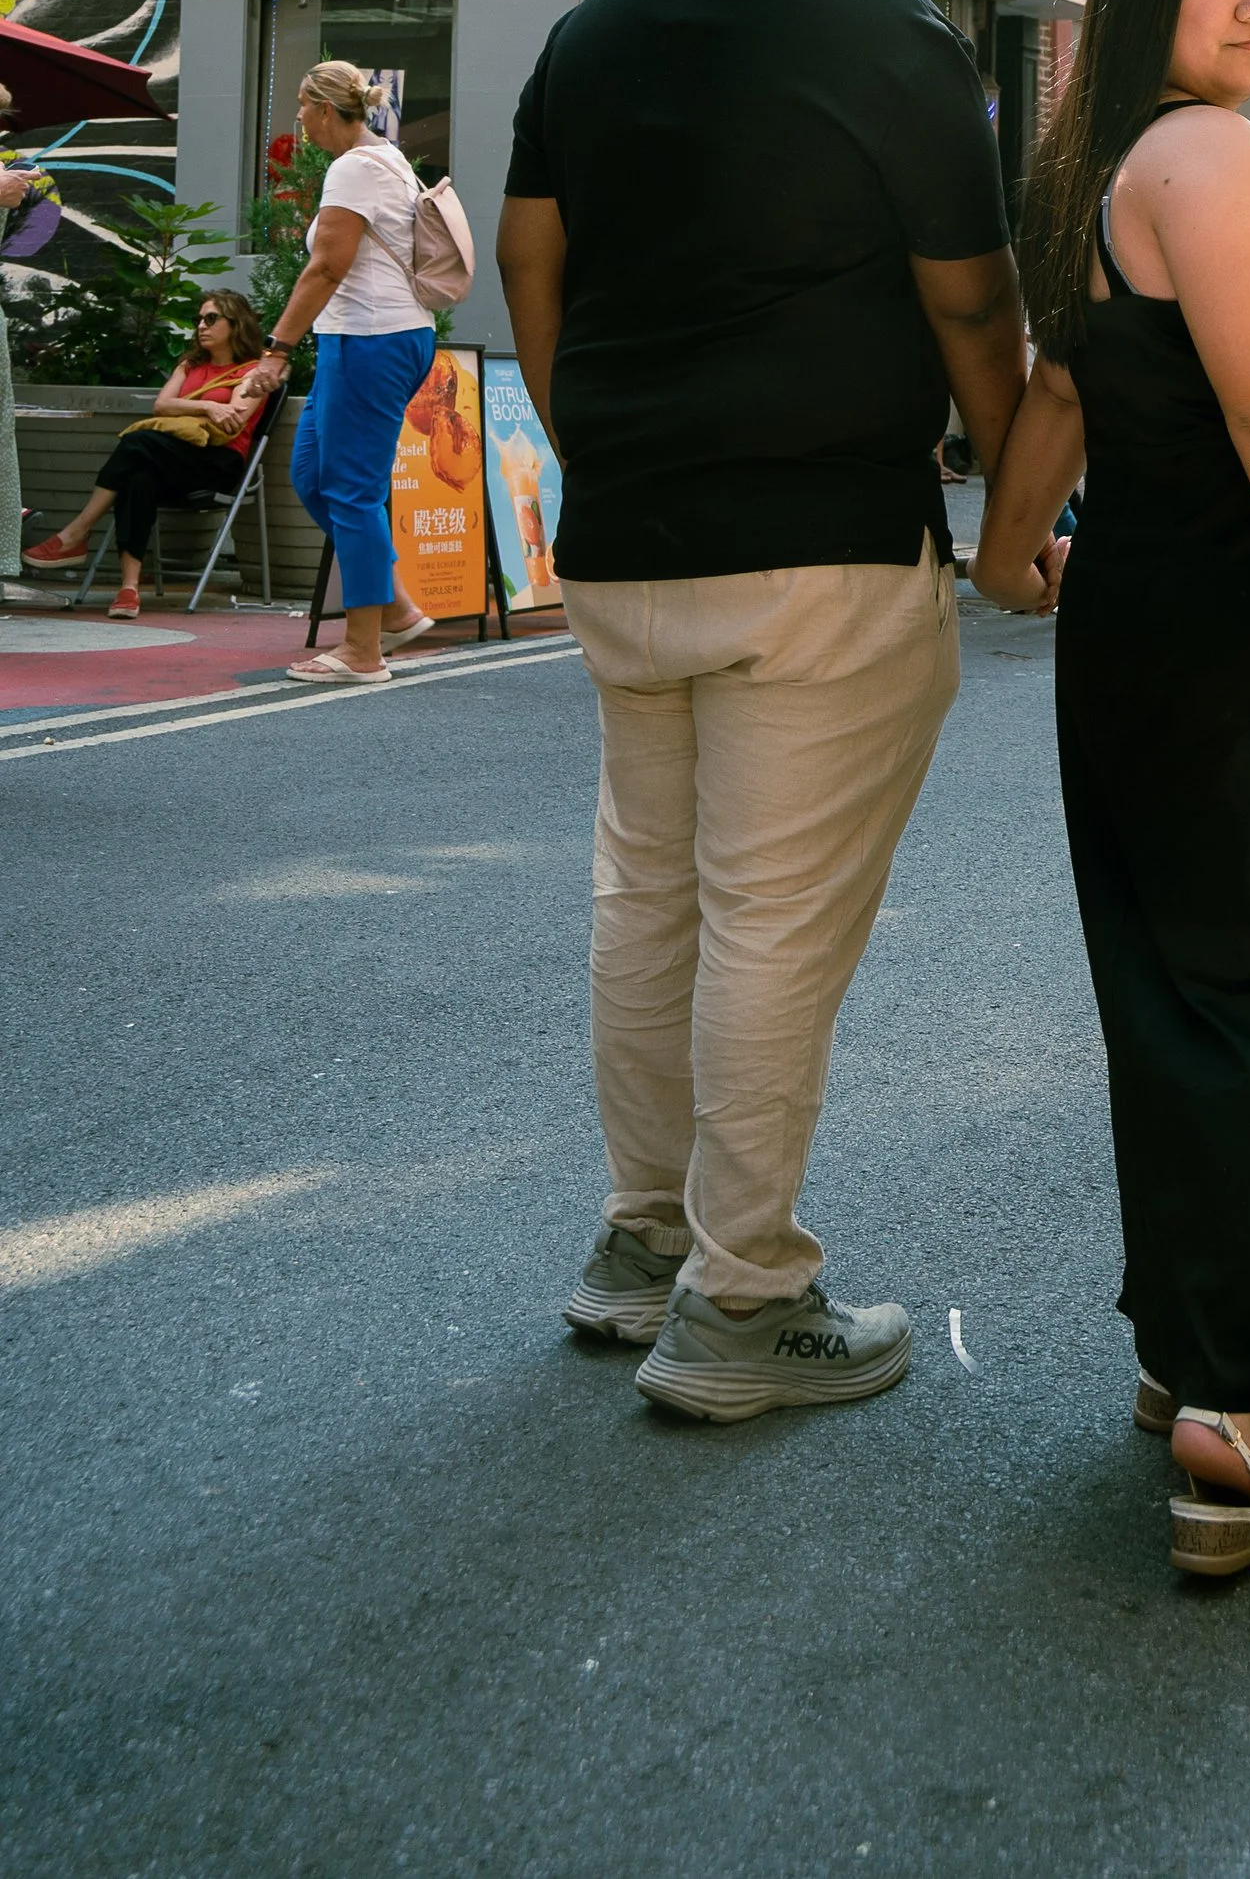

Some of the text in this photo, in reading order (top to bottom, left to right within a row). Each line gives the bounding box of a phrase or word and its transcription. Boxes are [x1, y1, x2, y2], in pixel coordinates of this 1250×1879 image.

[492, 404, 534, 421] BOOM
[392, 477, 419, 490] nata
[413, 507, 467, 537] 殿堂级
[773, 1329, 850, 1359] HOKA
